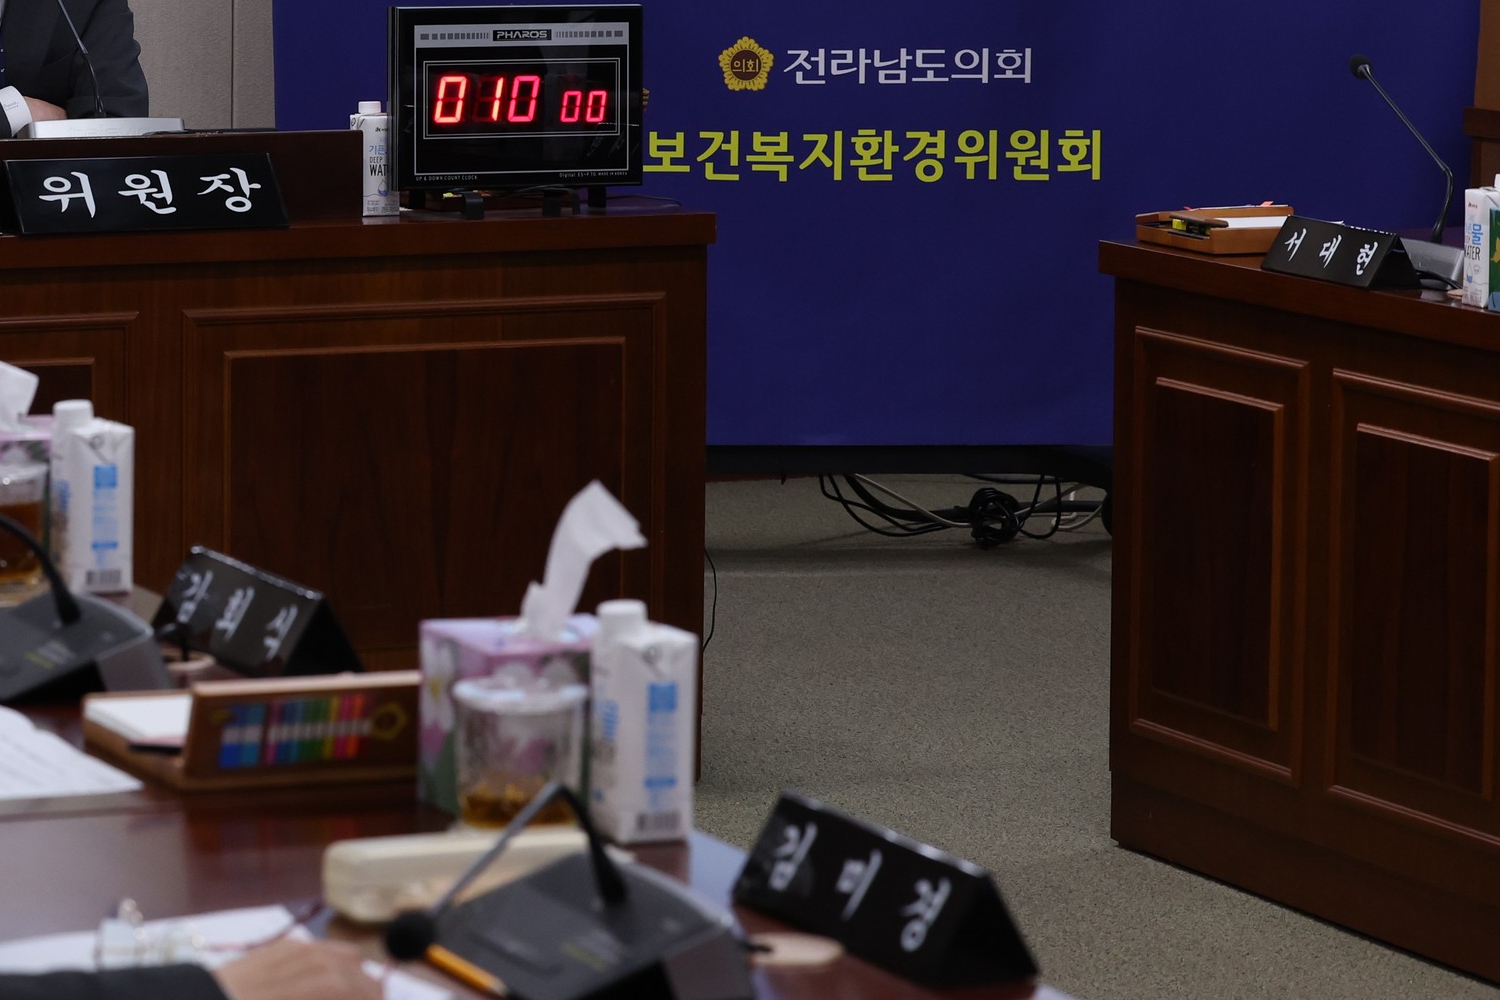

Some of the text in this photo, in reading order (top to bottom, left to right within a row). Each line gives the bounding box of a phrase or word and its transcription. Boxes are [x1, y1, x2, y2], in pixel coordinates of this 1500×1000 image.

[496, 30, 548, 39] PHAROS
[732, 58, 759, 73] 의회
[783, 47, 1032, 85] 전라남도의회
[644, 129, 1101, 183] 보건복지환경위원회
[38, 167, 262, 218] 위원장
[1284, 228, 1378, 276] 서대현
